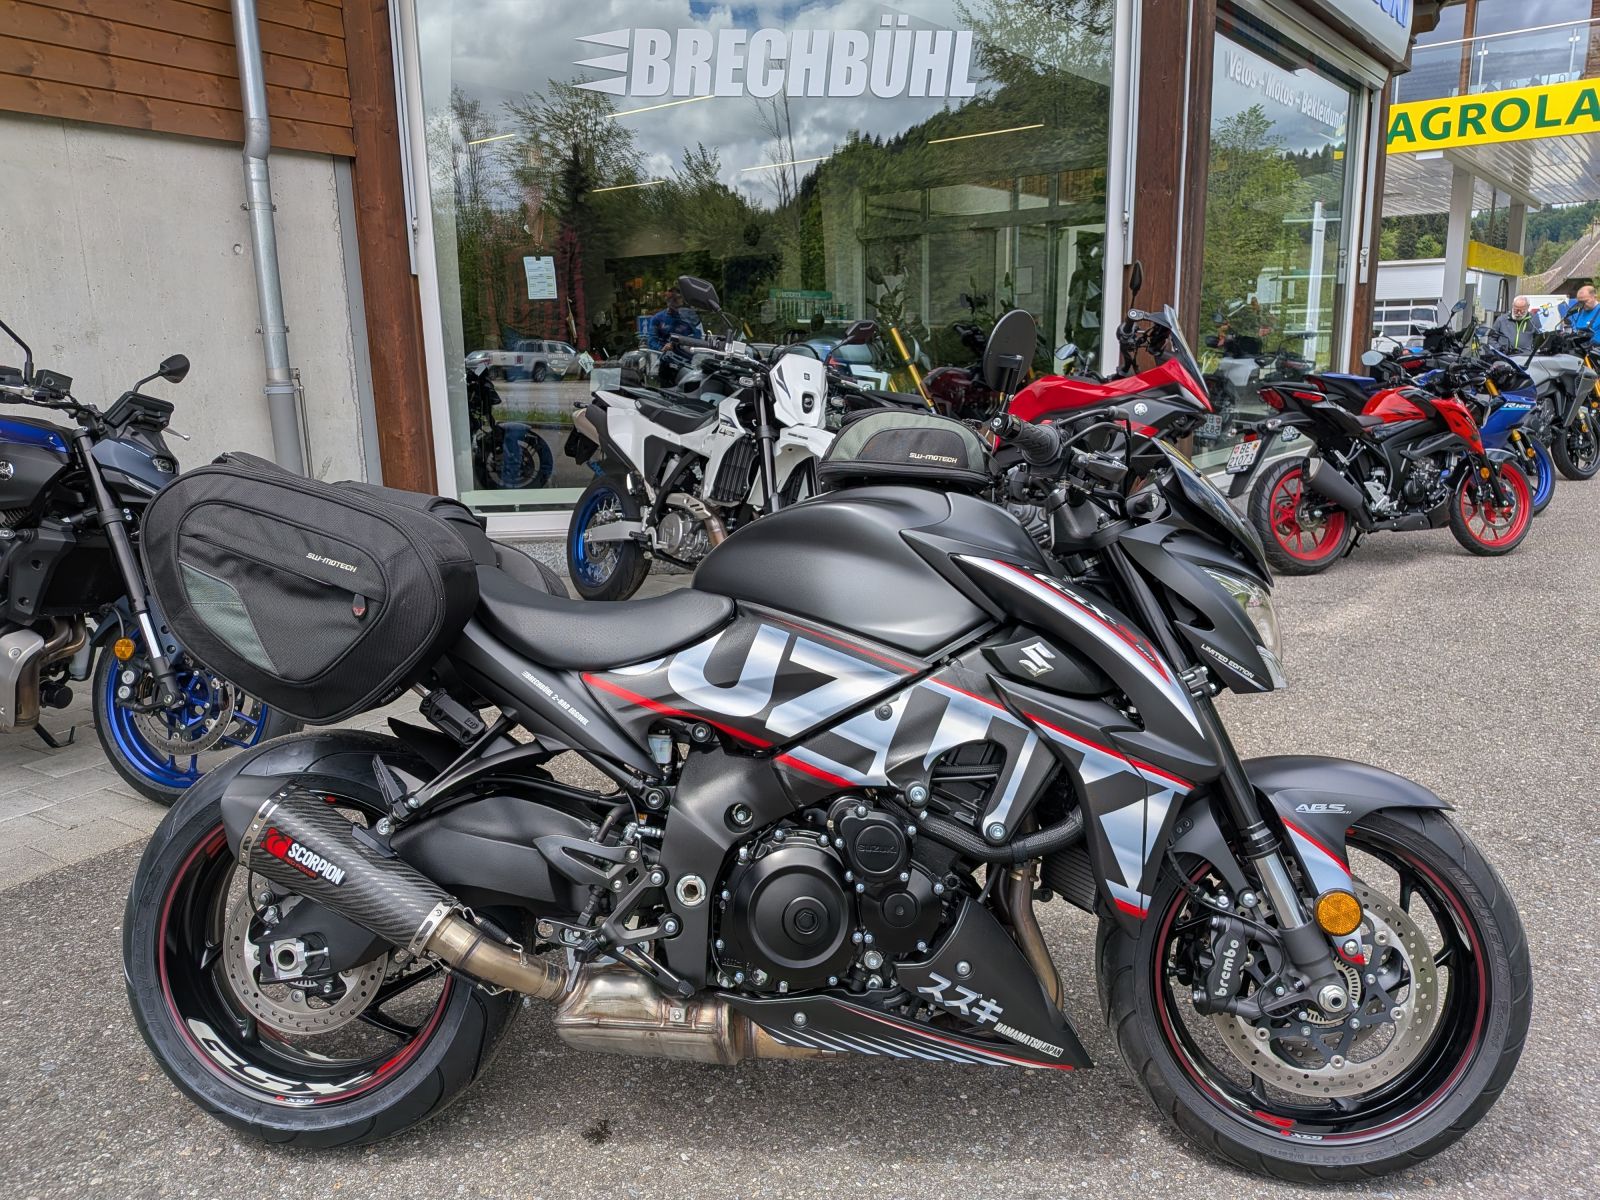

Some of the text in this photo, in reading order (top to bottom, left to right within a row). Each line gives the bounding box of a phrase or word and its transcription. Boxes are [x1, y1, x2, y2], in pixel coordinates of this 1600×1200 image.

[630, 14, 977, 99] BRECHBÜHL
[1228, 50, 1257, 89] Velos
[1265, 72, 1295, 107] Motos
[1388, 87, 1600, 145] AGROLA
[908, 452, 958, 464] SW-MOTECH
[1228, 453, 1254, 467] 21073
[1240, 442, 1253, 451] BE
[306, 552, 359, 573] SW-MOTECH
[1200, 643, 1255, 679] LIMITED EDITION
[608, 620, 1182, 897] UZUKI
[1295, 803, 1347, 812] ABS
[287, 842, 346, 885] SCORPION
[1448, 866, 1511, 987] MICHELIN
[1214, 939, 1240, 997] brembo
[916, 971, 1004, 1024] スズキ
[993, 1022, 1065, 1058] HAMAMATSU JAPAN
